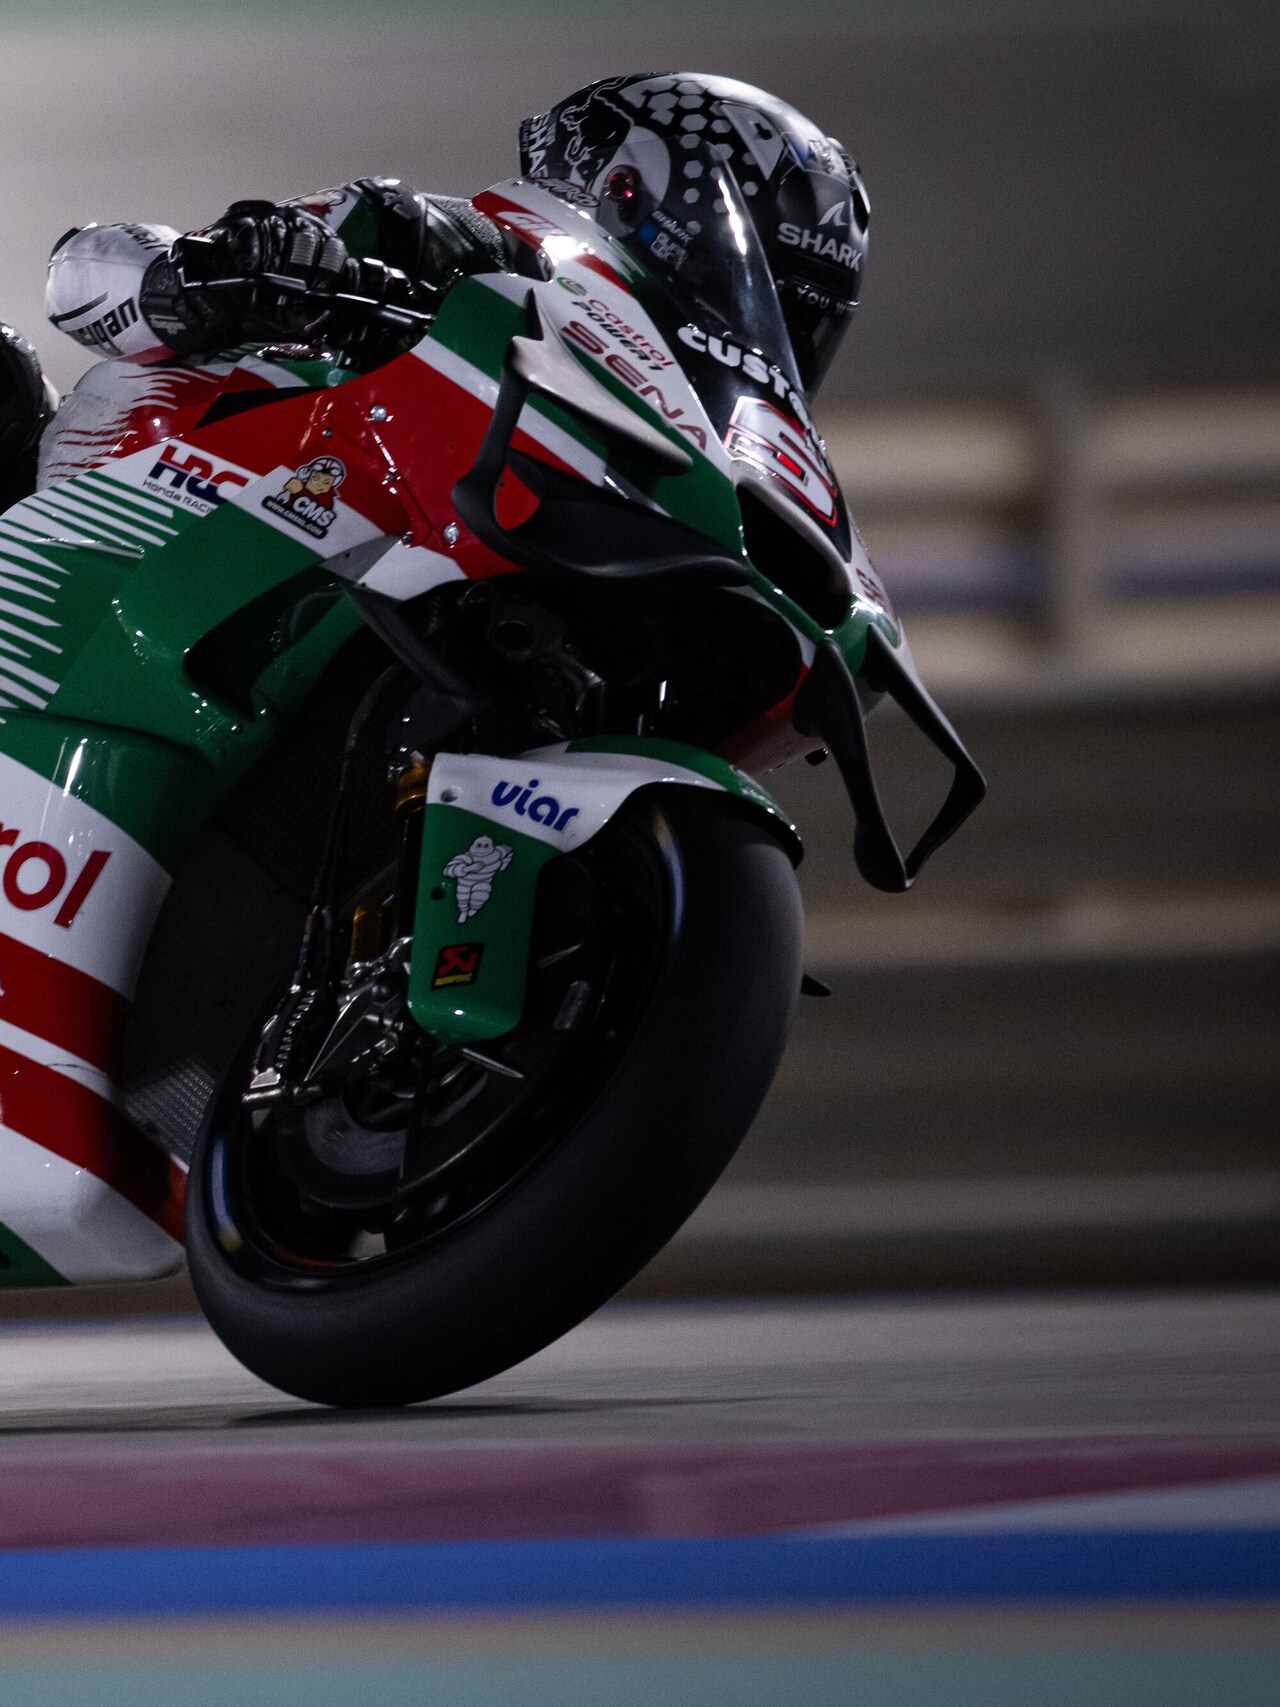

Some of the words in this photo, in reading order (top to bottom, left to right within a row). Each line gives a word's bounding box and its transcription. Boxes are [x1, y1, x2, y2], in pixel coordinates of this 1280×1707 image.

[777, 222, 863, 272] SHARK
[588, 298, 676, 368] Castrol
[560, 320, 709, 451] SENA
[143, 479, 184, 504] Honda
[184, 496, 215, 513] RACI
[148, 444, 250, 506] HRC
[293, 495, 334, 527] CMS
[492, 780, 580, 832] viar
